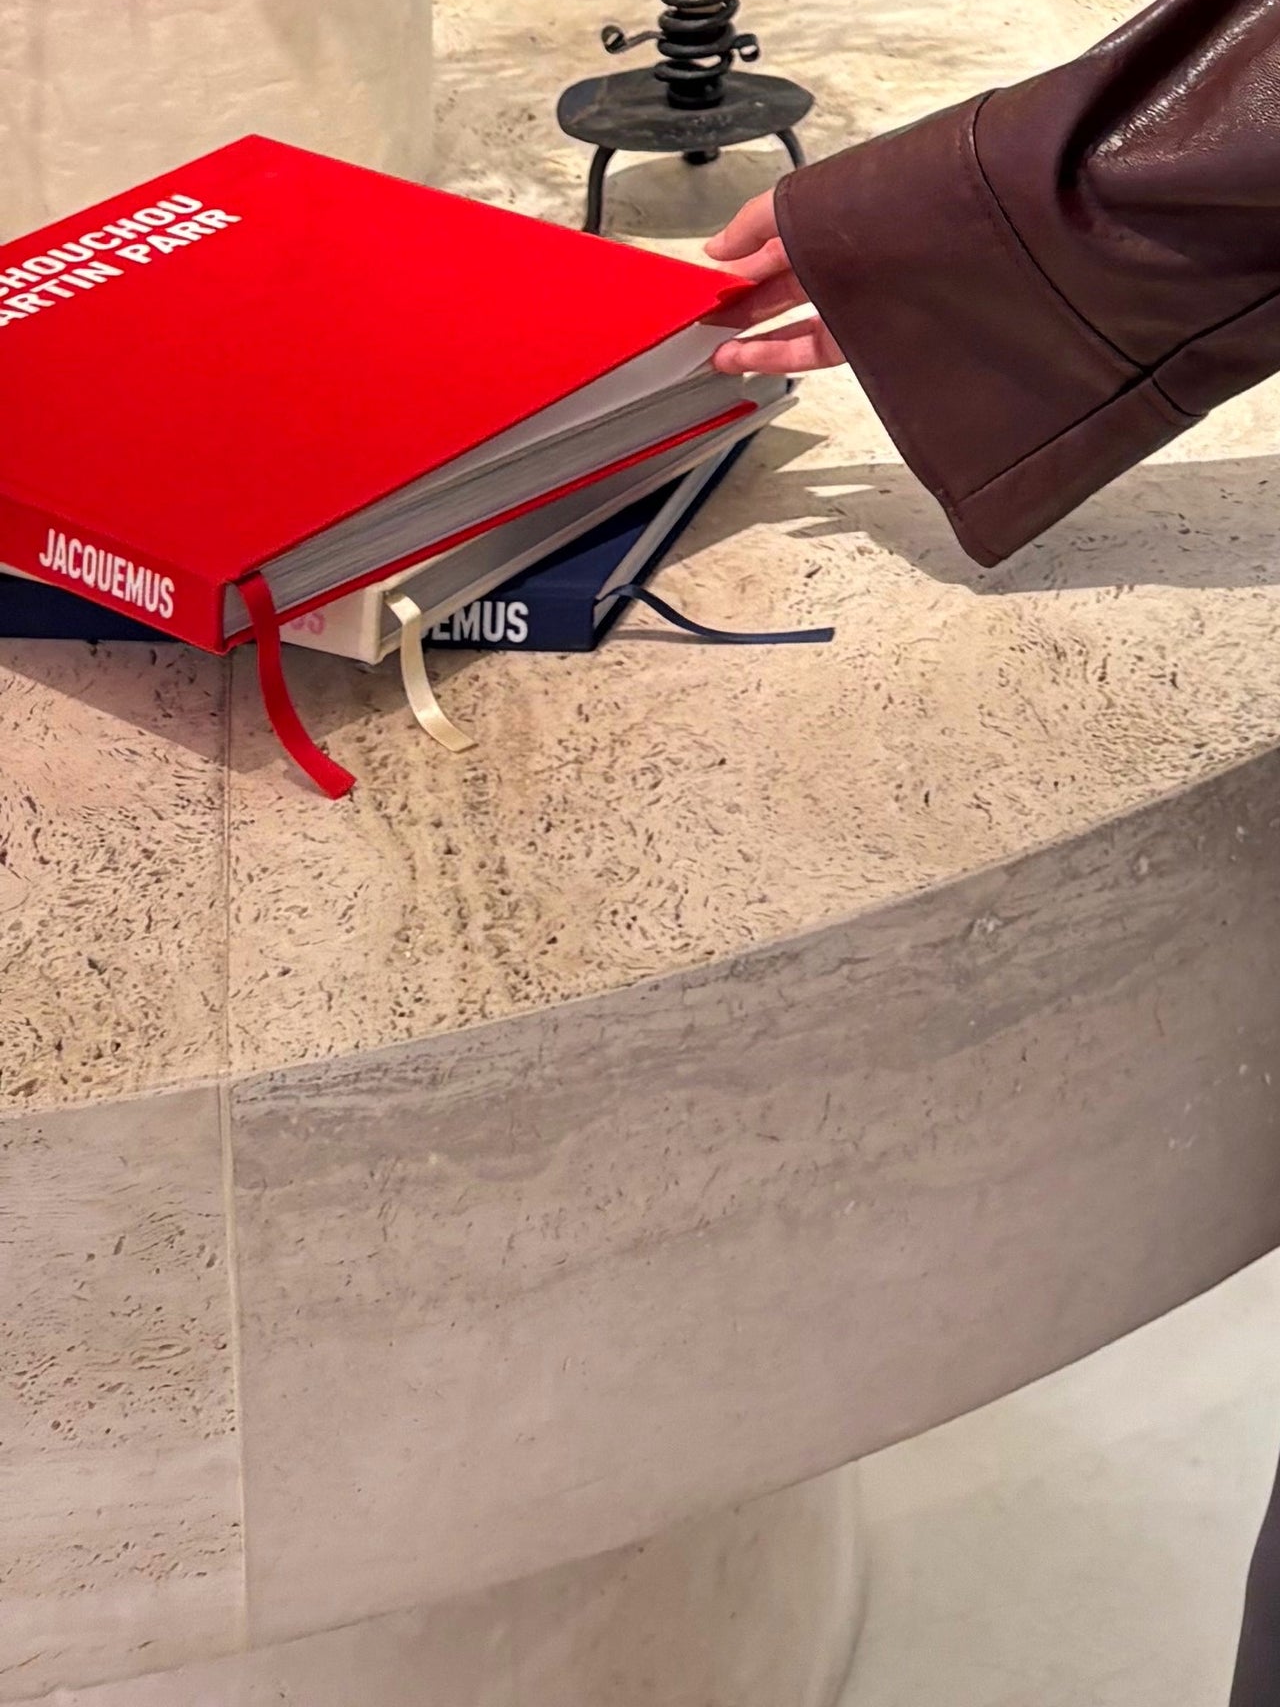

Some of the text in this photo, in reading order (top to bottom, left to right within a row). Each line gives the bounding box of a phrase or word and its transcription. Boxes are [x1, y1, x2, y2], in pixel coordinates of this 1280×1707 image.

[0, 194, 203, 297] HOUCHOU
[115, 209, 243, 264] PARR
[39, 528, 175, 619] JACQUEMUS
[421, 600, 529, 643] EMUS
